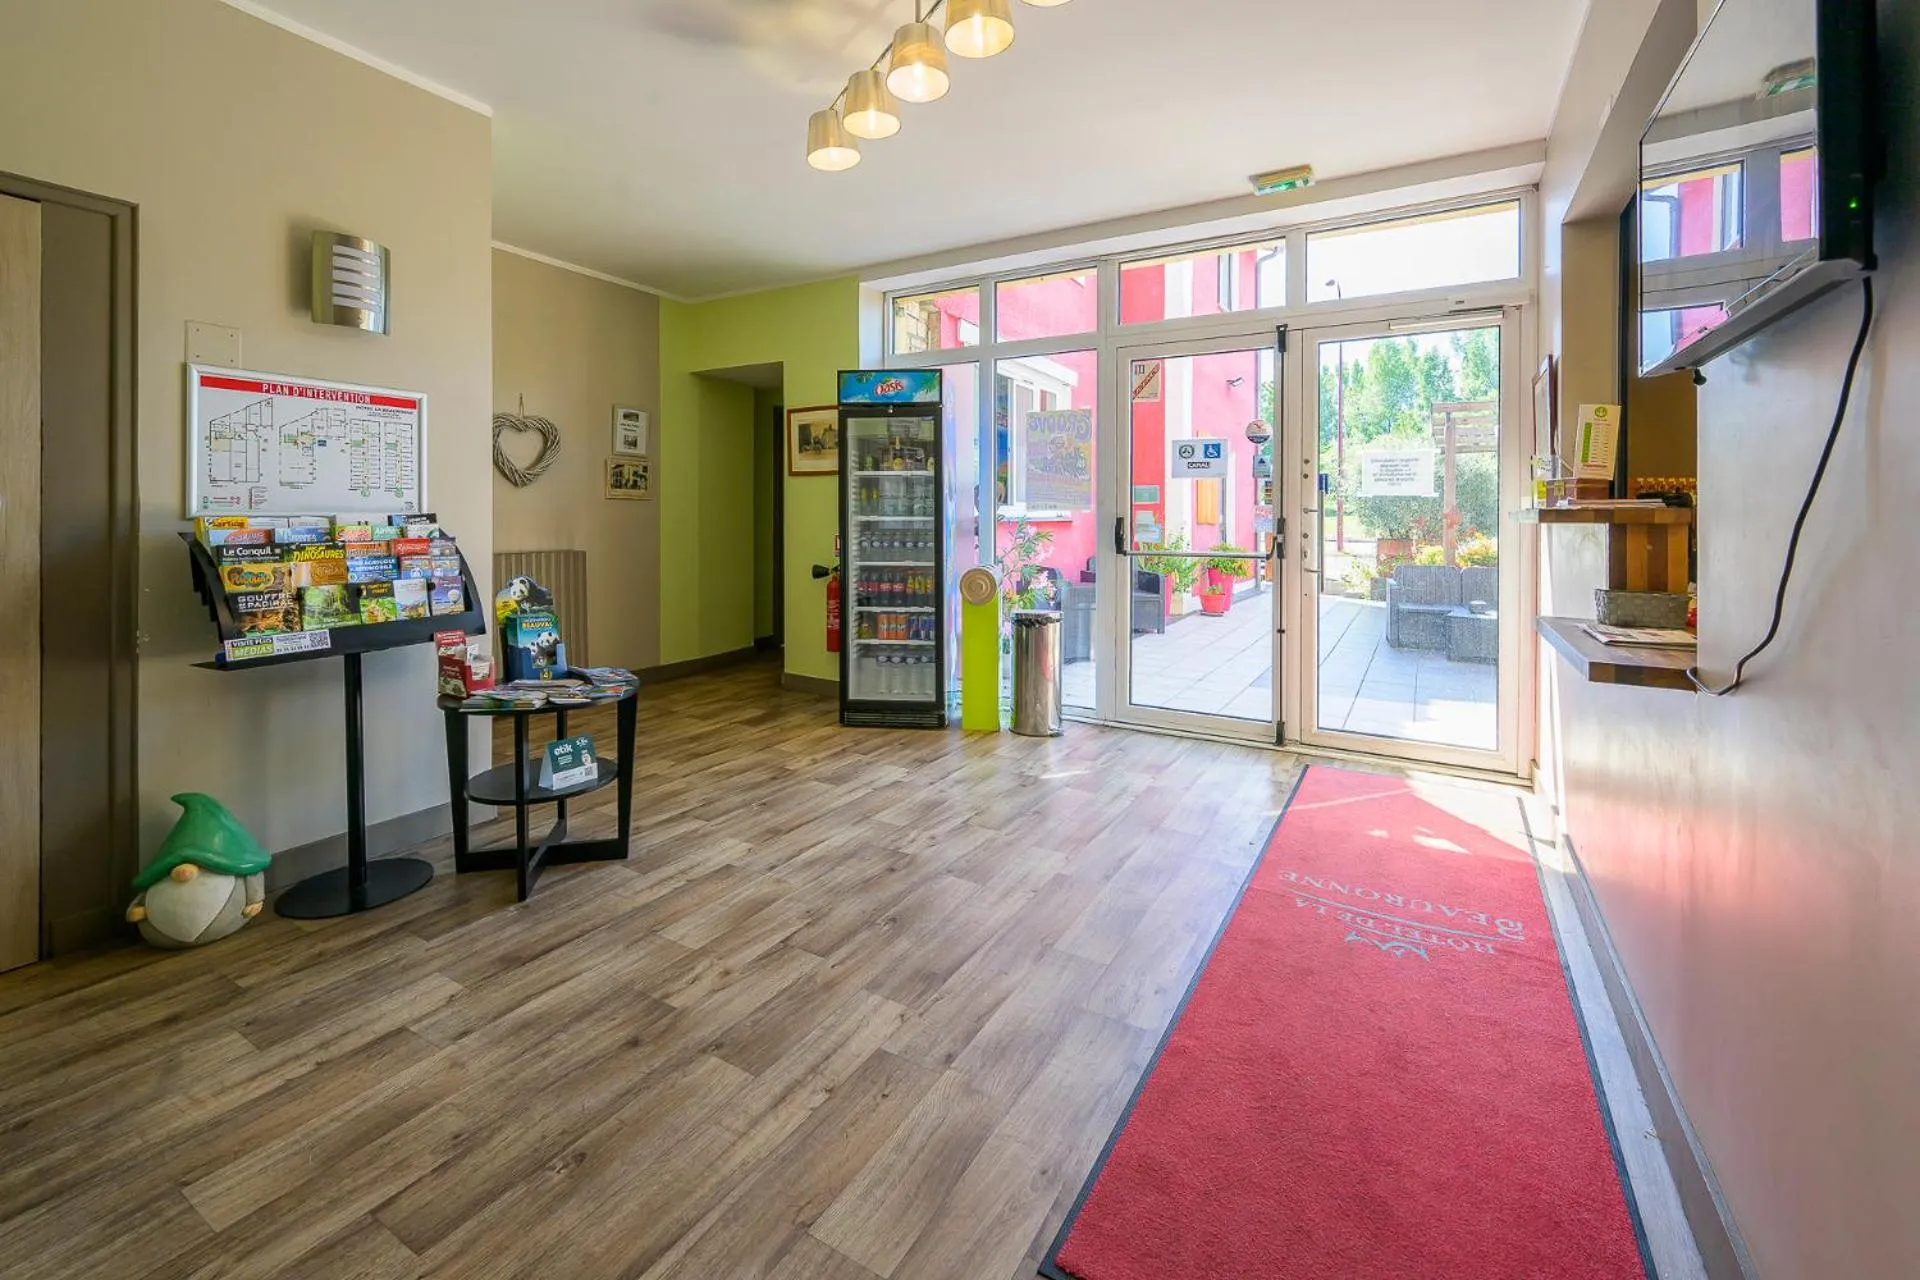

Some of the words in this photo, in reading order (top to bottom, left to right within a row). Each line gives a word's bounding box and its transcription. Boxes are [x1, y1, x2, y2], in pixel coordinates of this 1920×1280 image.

[262, 384, 289, 395] PLAN
[293, 386, 371, 404] D'INTERVENTION
[874, 380, 904, 396] Oasis
[223, 547, 235, 556] Le
[237, 546, 272, 558] Conquil
[293, 549, 345, 561] DINOSAURES
[237, 592, 292, 603] GOUFFRE
[1278, 870, 1525, 940] BEAURONNE
[1295, 898, 1329, 914] LA
[1337, 911, 1376, 928] DE
